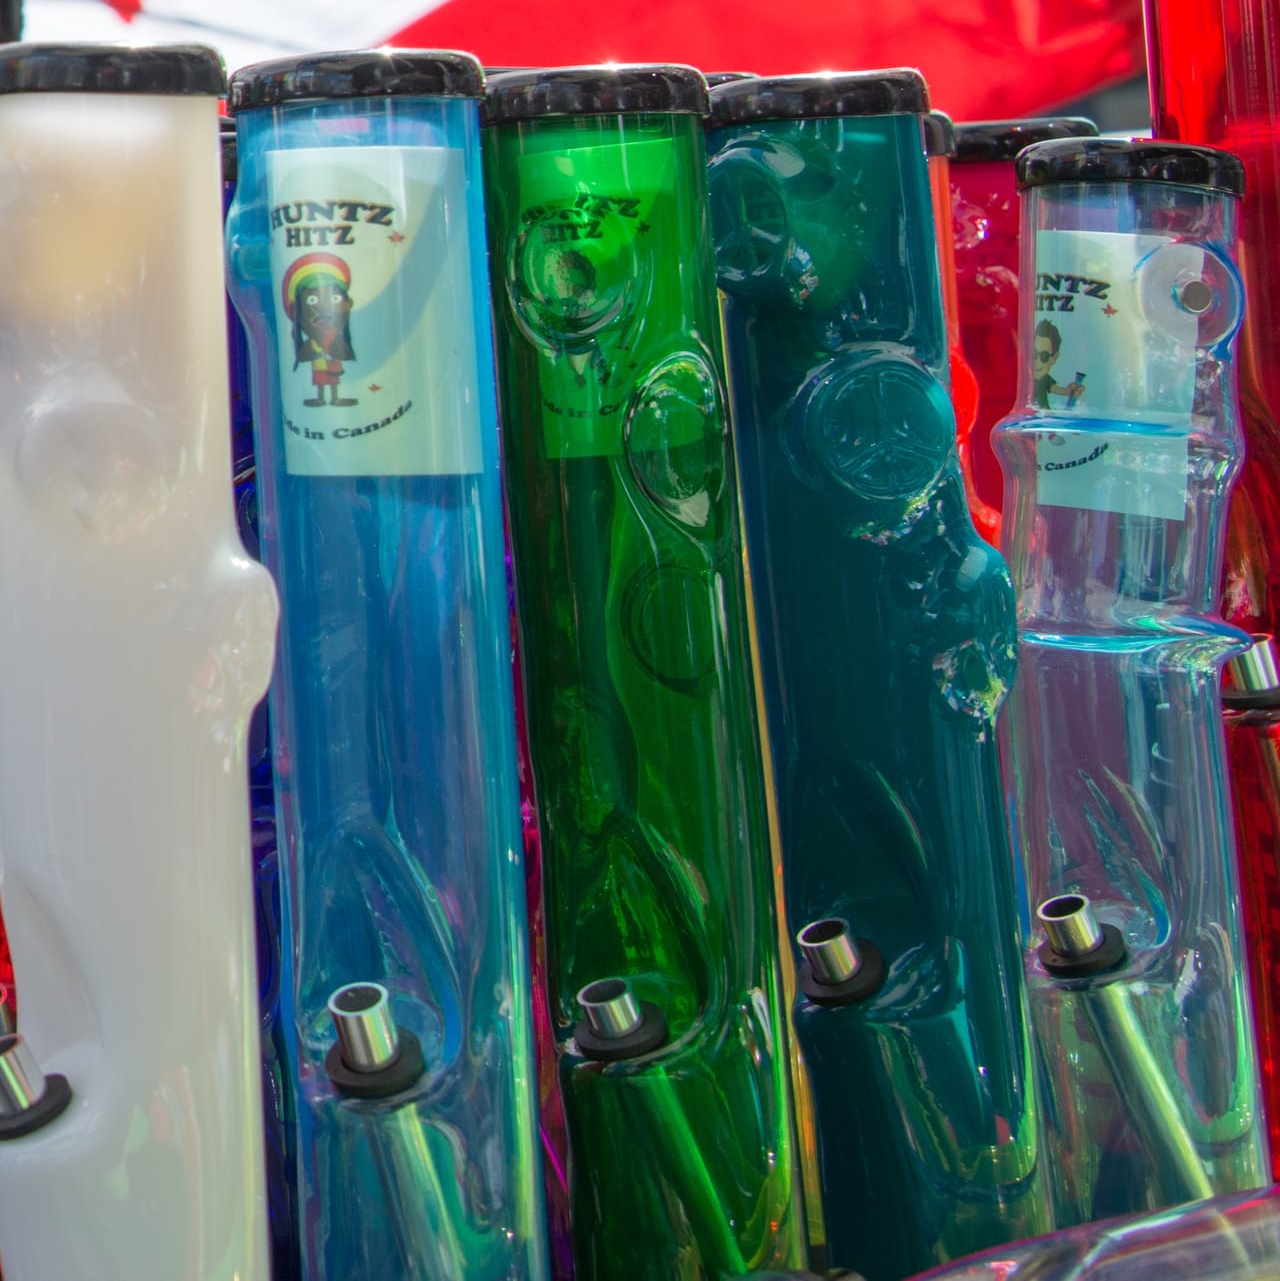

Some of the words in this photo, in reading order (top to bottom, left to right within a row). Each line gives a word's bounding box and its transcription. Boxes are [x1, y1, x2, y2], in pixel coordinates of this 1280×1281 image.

[286, 225, 355, 247] HITZ
[304, 427, 325, 440] in
[332, 399, 413, 439] Canada
[1044, 442, 1109, 471] Canada
